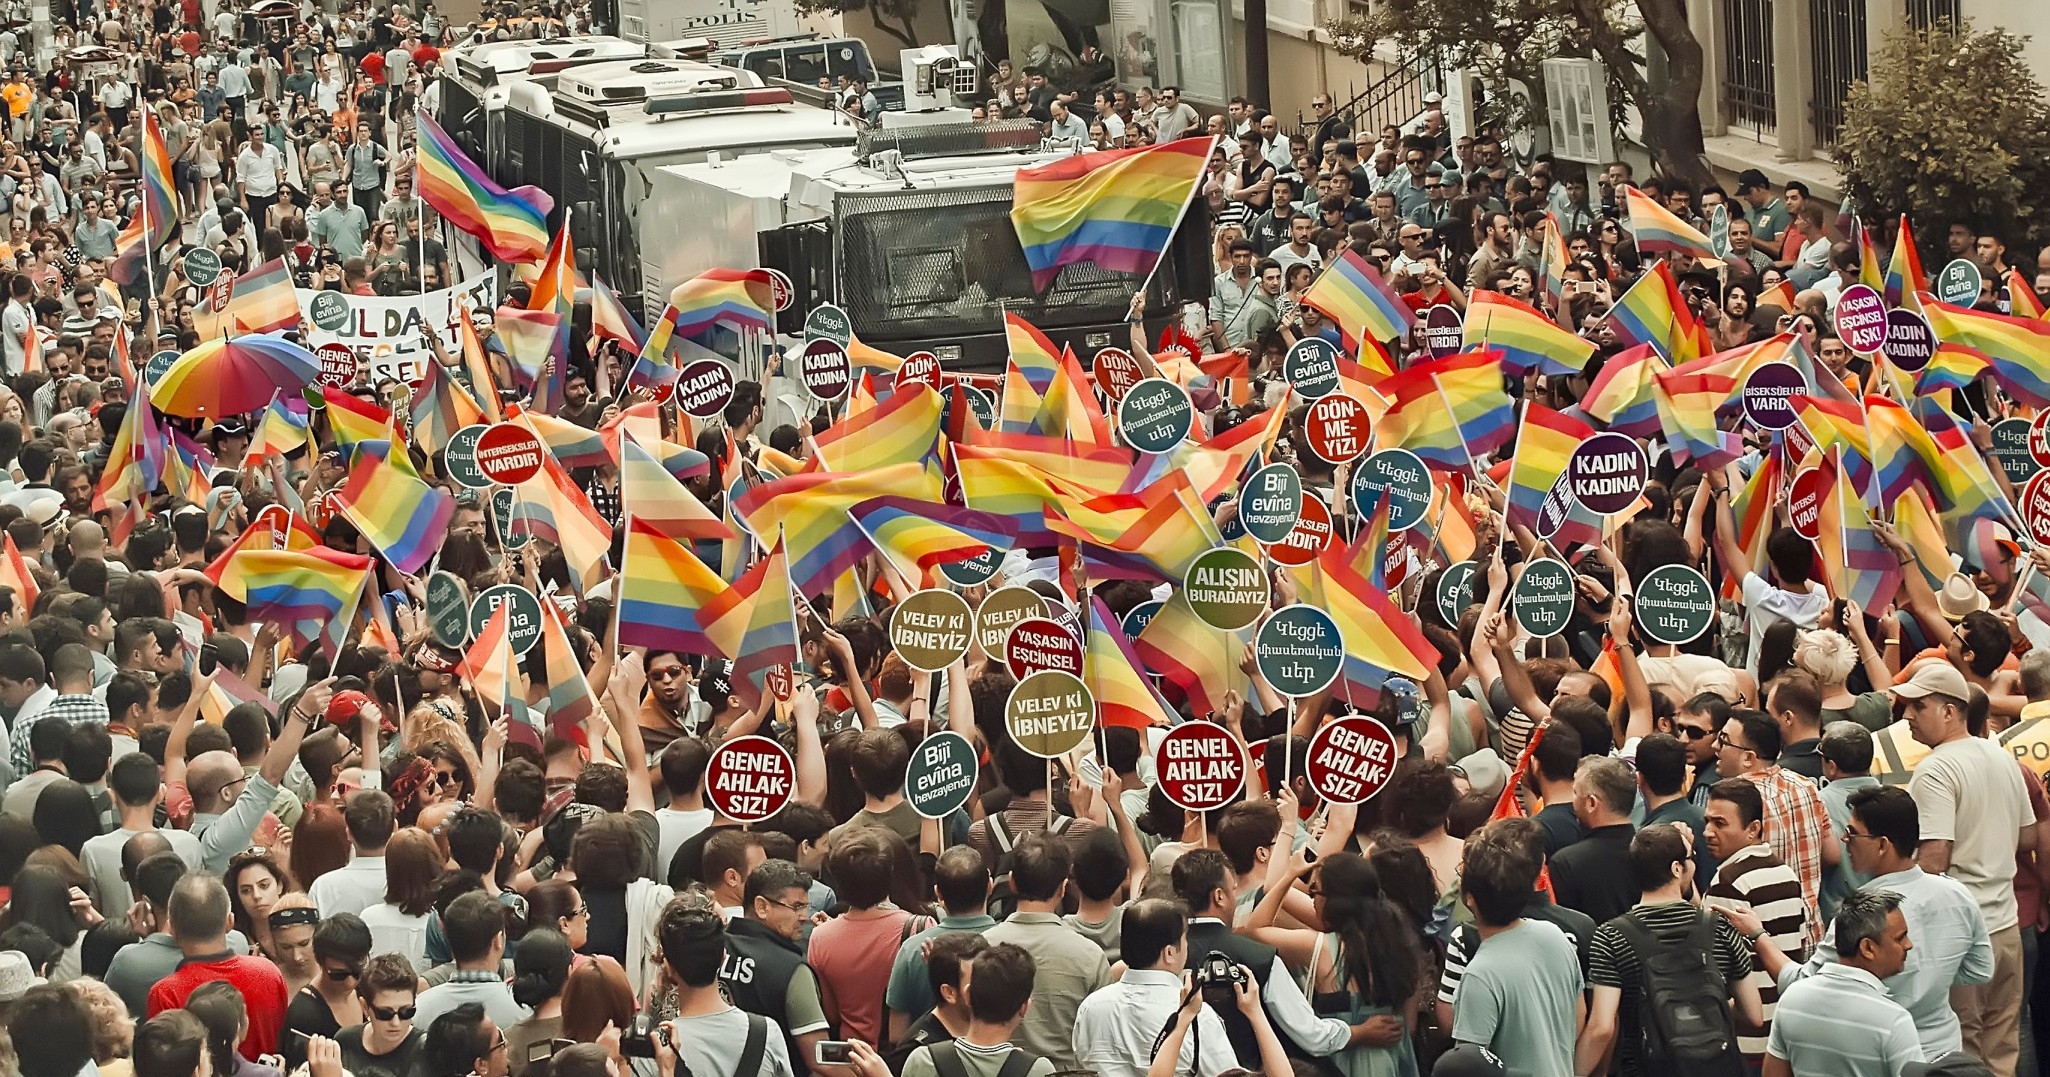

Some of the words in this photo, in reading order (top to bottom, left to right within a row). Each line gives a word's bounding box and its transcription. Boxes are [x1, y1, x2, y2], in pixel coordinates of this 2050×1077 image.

[1839, 295, 1877, 313] YAŞASIN
[1839, 311, 1884, 331] EŞCİNSEL
[1852, 327, 1882, 347] AŞK!
[318, 349, 353, 364] GENEL
[804, 351, 844, 371] KADIN
[1298, 345, 1321, 363] Bijî
[1884, 343, 1930, 358] KADINA
[905, 357, 937, 378] DÖN-
[1100, 353, 1136, 370] DÖN-
[1294, 360, 1332, 379] evîna
[678, 366, 726, 396] KADIN
[805, 369, 848, 388] KADINA
[1109, 369, 1136, 386] ME-
[682, 381, 731, 412] KADINA
[1745, 386, 1806, 396] BİSEKSÜELLER
[1317, 399, 1361, 421] DÖN-
[1148, 423, 1176, 441] սեր
[1324, 419, 1357, 439] ME-
[1324, 437, 1357, 457] YİZ!
[485, 452, 539, 474] VARDIR
[1576, 452, 1637, 474] KADIN
[1264, 473, 1289, 495] Bijî
[1575, 475, 1641, 496] KADINA
[1252, 495, 1293, 511] evîna
[1246, 511, 1296, 526] hevzayendî
[1195, 567, 1260, 590] ALIŞIN
[1526, 572, 1564, 590] Կեցցե
[1654, 578, 1699, 597] Կեցցե
[1189, 588, 1266, 605] BURADAYIZ
[903, 610, 946, 629] VELEV
[949, 613, 965, 630] Kİ
[982, 608, 1021, 627] VELEV
[1531, 607, 1557, 625] սեր
[1659, 614, 1690, 633] սեր
[895, 626, 967, 651] İBNEYİZ
[1017, 628, 1073, 651] YAŞASIN
[1275, 621, 1326, 642] Կեցցե
[1012, 645, 1077, 671] EŞCİNSEL
[1281, 661, 1315, 684] սեր
[1016, 695, 1061, 715] VELEV
[1066, 690, 1082, 709] Kİ
[1013, 709, 1089, 738] İBNEYİZ
[924, 742, 952, 767] Bijî
[1166, 738, 1233, 759] GENEL
[1328, 725, 1390, 764] GENEL
[720, 750, 785, 774] GENEL
[1166, 760, 1241, 781] AHLAK-
[1315, 746, 1387, 785] AHLAK-
[715, 772, 790, 796] AHLAK-
[917, 762, 963, 791] evîna
[1321, 773, 1363, 801] SIZ!
[914, 775, 971, 805] hevzayendî
[1182, 783, 1223, 804] SIZ!
[728, 794, 769, 816] SIZ!
